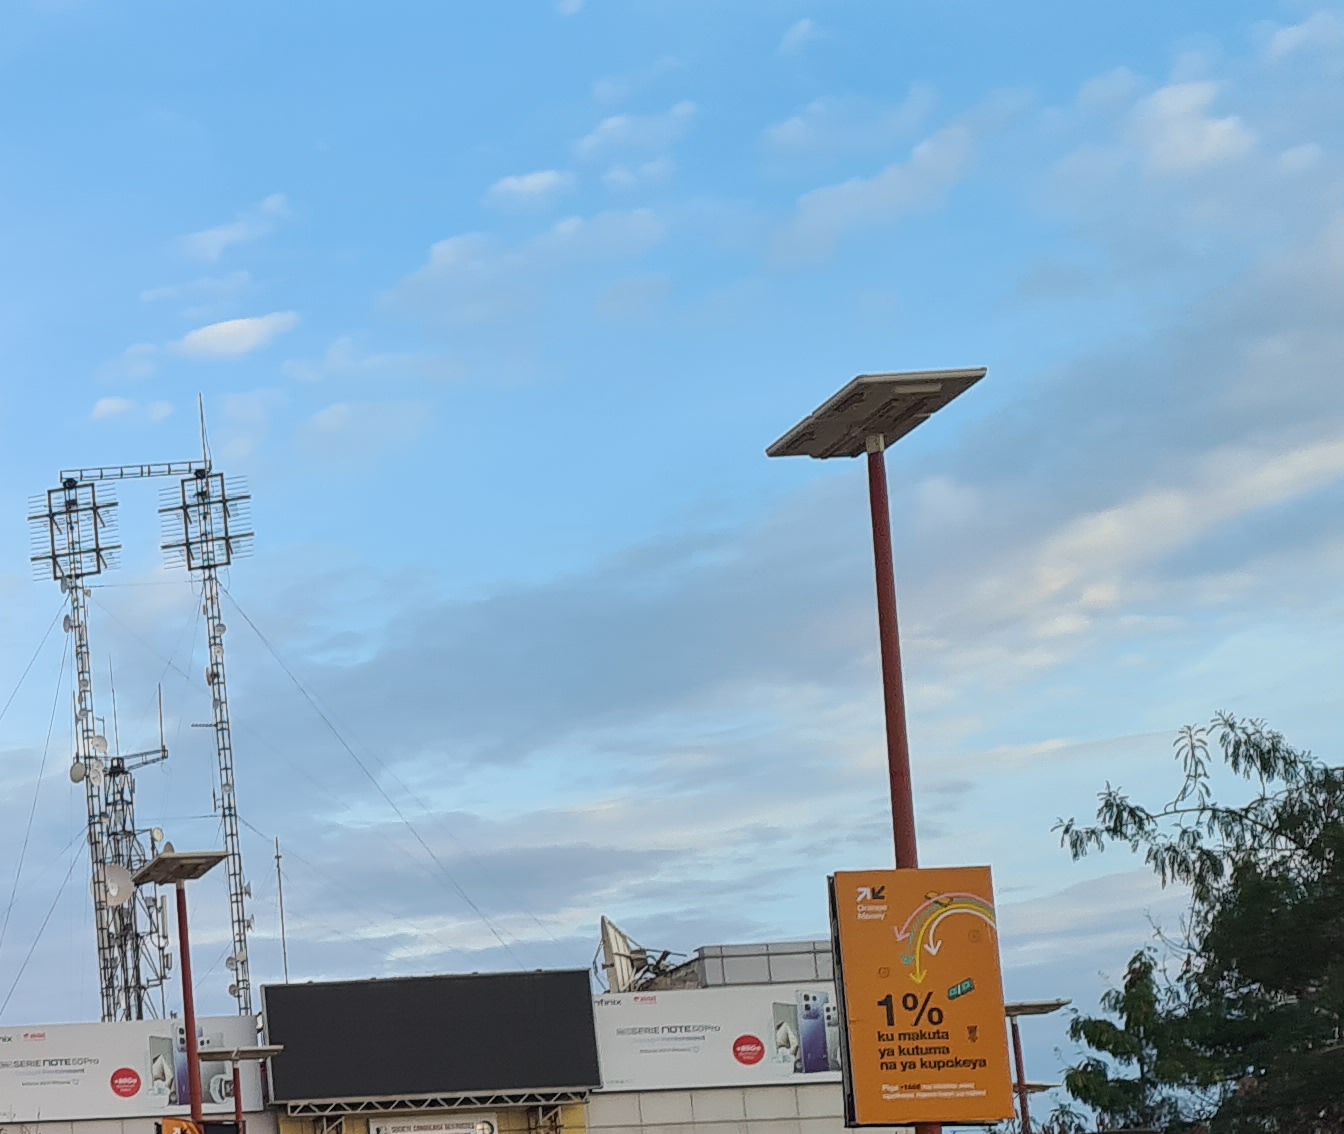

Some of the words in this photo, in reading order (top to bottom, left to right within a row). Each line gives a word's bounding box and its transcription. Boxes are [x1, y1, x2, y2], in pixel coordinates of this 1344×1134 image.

[877, 991, 944, 1026] 1%
[877, 1031, 895, 1042] ku
[898, 1030, 950, 1042] makuta
[878, 1046, 895, 1059] ya
[898, 1045, 951, 1056] kutuma
[879, 1059, 897, 1070] na
[900, 1060, 917, 1072] ya
[919, 1056, 987, 1070] kupokeya
